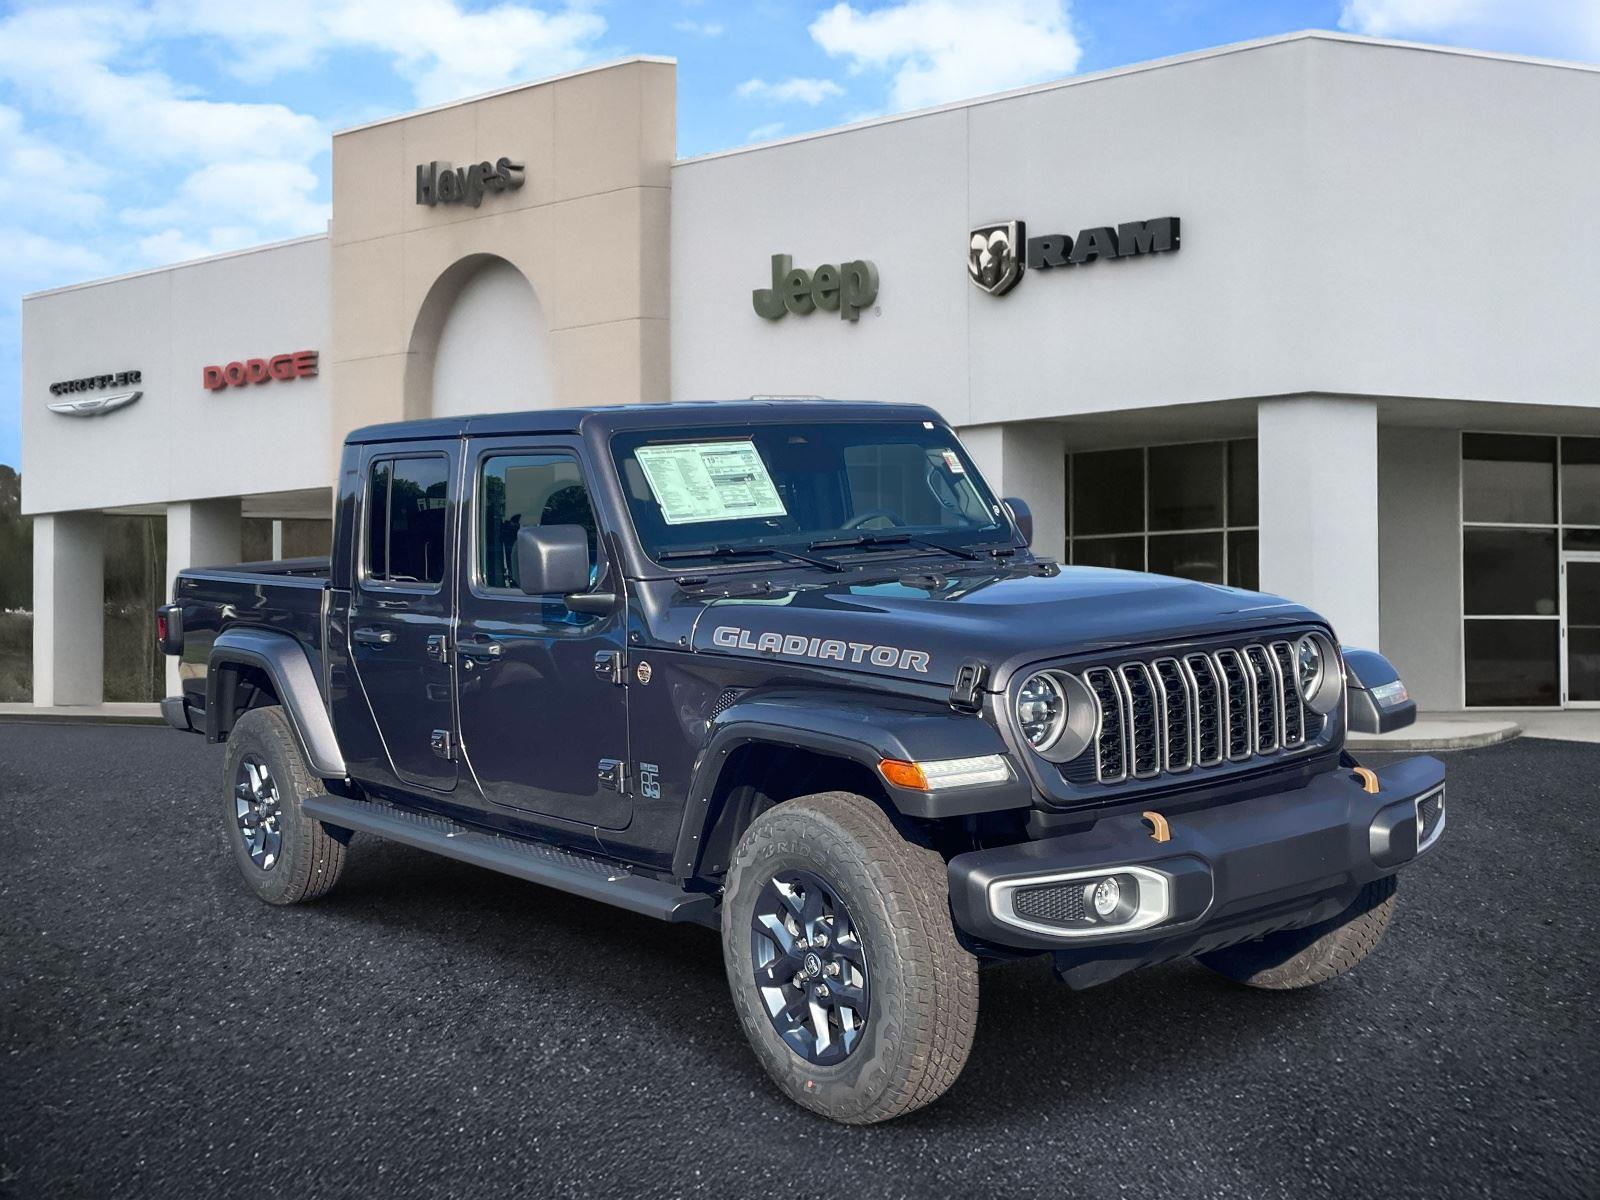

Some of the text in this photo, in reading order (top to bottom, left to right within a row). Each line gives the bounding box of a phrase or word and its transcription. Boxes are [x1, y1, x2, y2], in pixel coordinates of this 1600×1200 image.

[416, 157, 525, 208] Hayes
[1027, 217, 1181, 270] RAM
[752, 253, 879, 322] Jeep
[49, 370, 142, 396] CHRYSLER
[203, 350, 319, 393] DODGE
[713, 626, 930, 673] GLADIATOR
